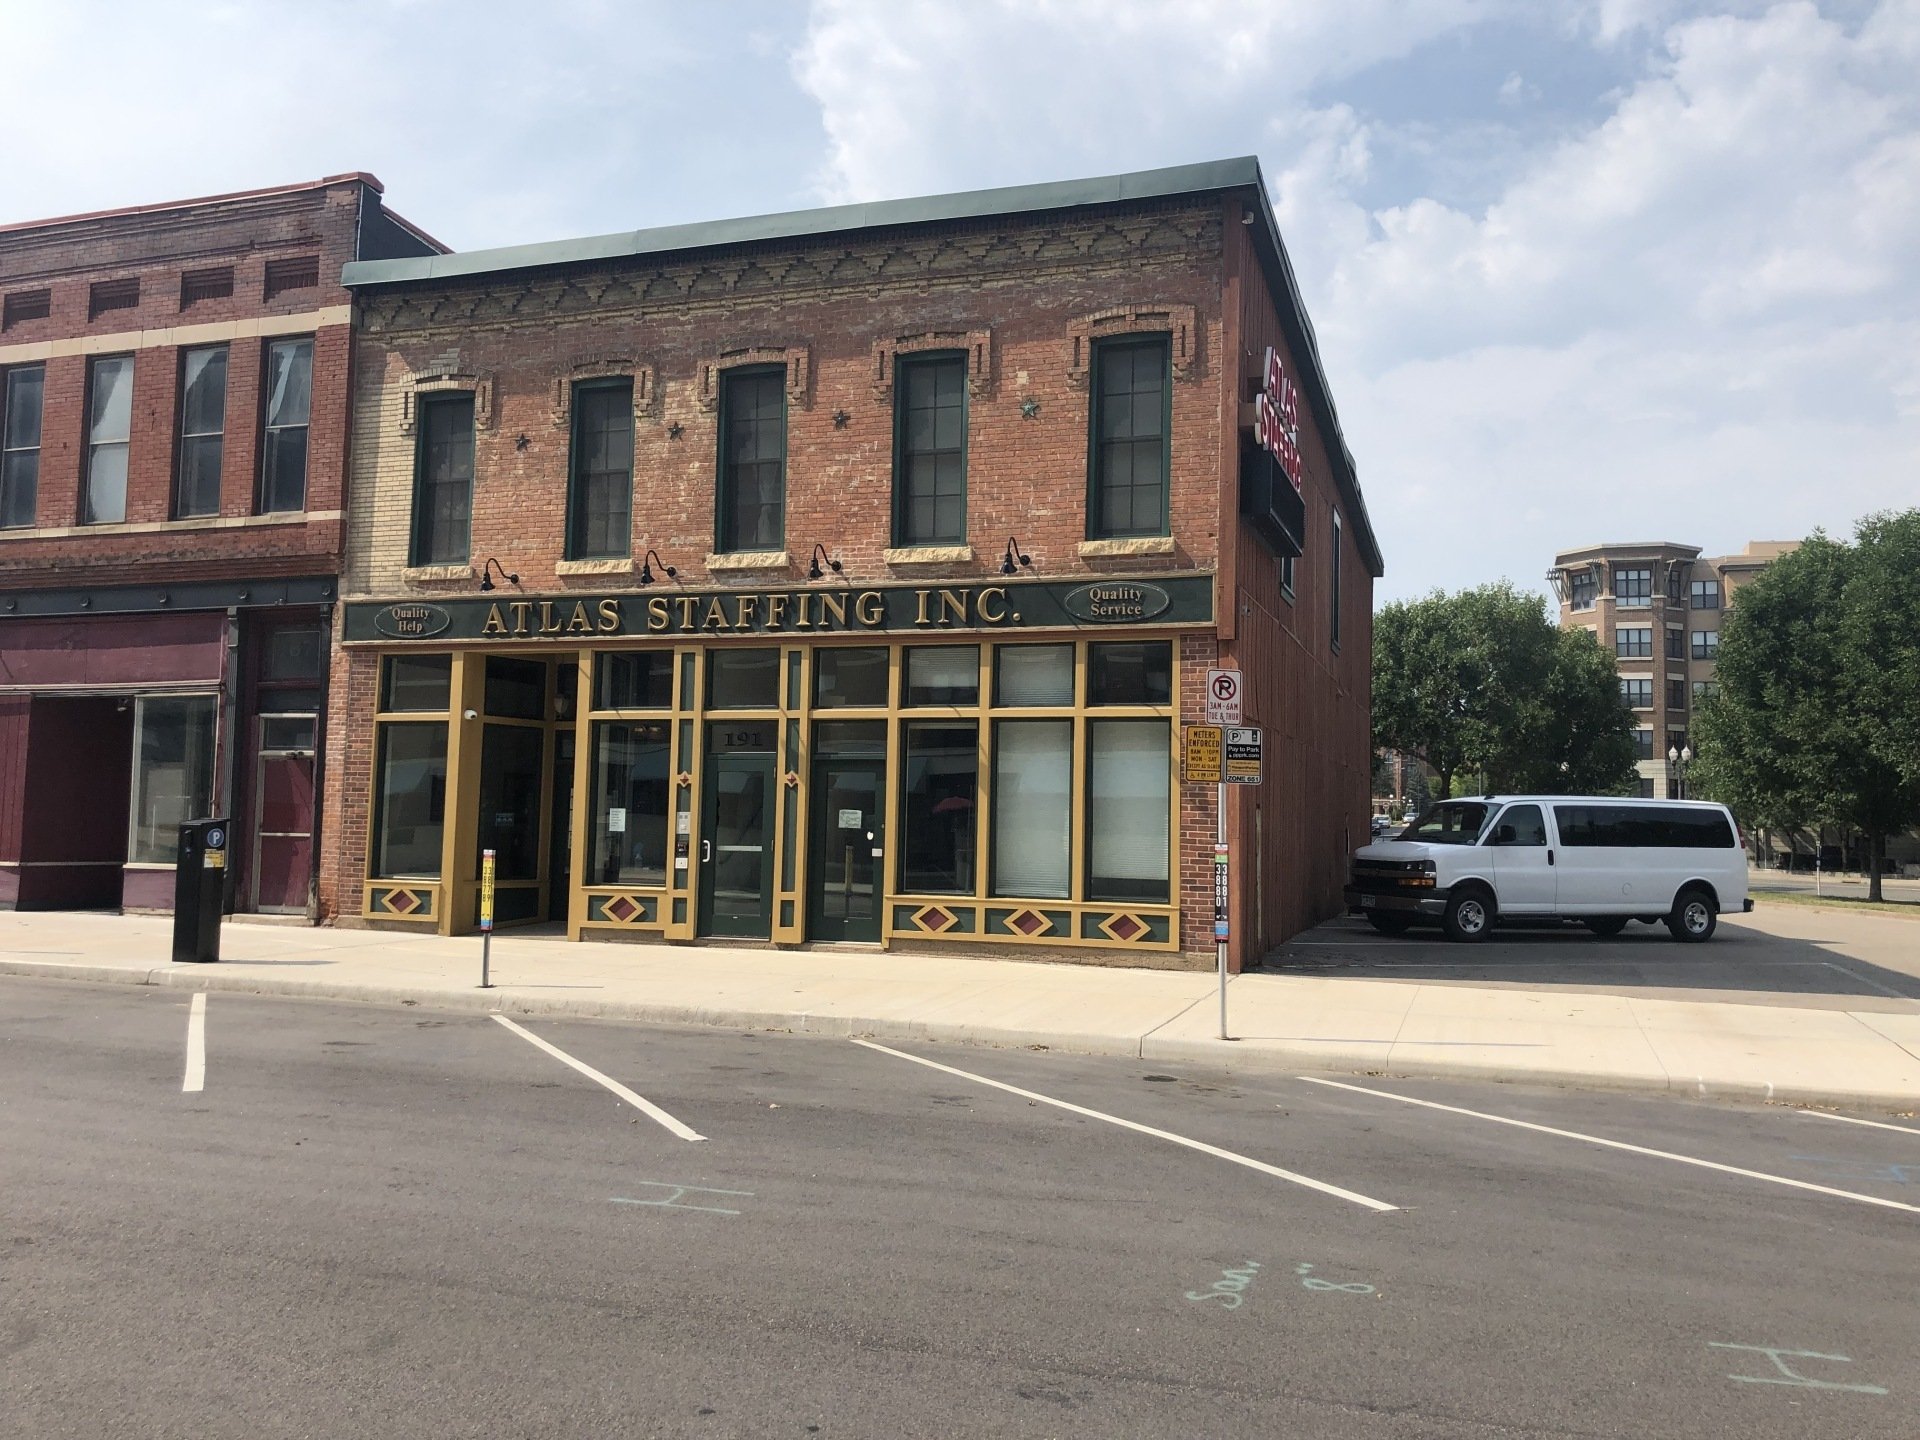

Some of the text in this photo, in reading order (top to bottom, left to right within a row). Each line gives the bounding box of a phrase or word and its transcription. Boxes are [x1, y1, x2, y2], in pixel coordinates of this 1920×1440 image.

[1267, 346, 1298, 433] ATLAS
[1089, 586, 1143, 604] Quality
[391, 605, 430, 622] Quality
[481, 587, 1021, 634] ATLAS STAFFING INC.
[1089, 602, 1142, 617] Service
[398, 620, 424, 634] Help
[1209, 702, 1222, 711] 3AM
[1225, 702, 1239, 711] 6AM
[1208, 711, 1218, 720] TUE
[1225, 712, 1239, 721] THUR
[723, 732, 763, 747] 191
[1193, 730, 1216, 739] METERS
[1188, 739, 1220, 748] ENFORCED
[212, 831, 220, 844] P
